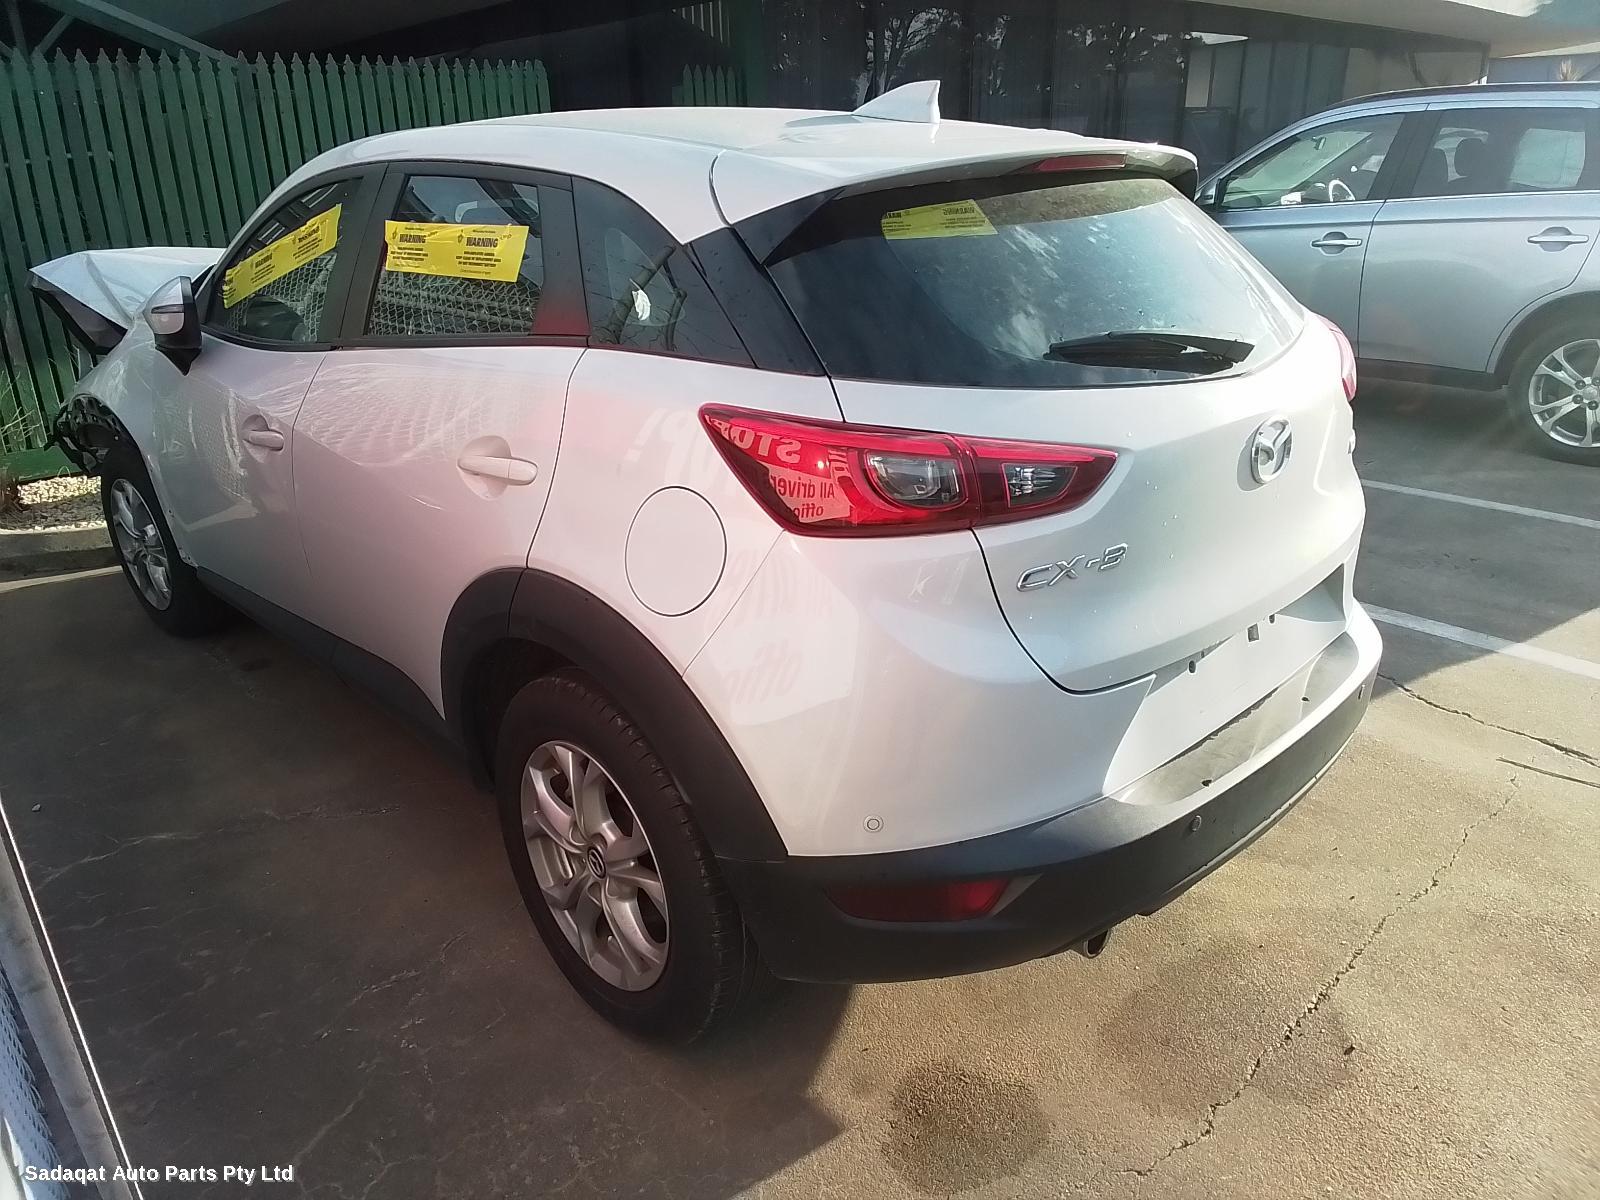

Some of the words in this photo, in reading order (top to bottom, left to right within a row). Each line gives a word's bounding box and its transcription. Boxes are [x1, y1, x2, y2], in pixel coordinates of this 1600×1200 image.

[399, 233, 427, 243] WARNING
[466, 236, 499, 248] WARNING
[1016, 543, 1128, 591] CX-3
